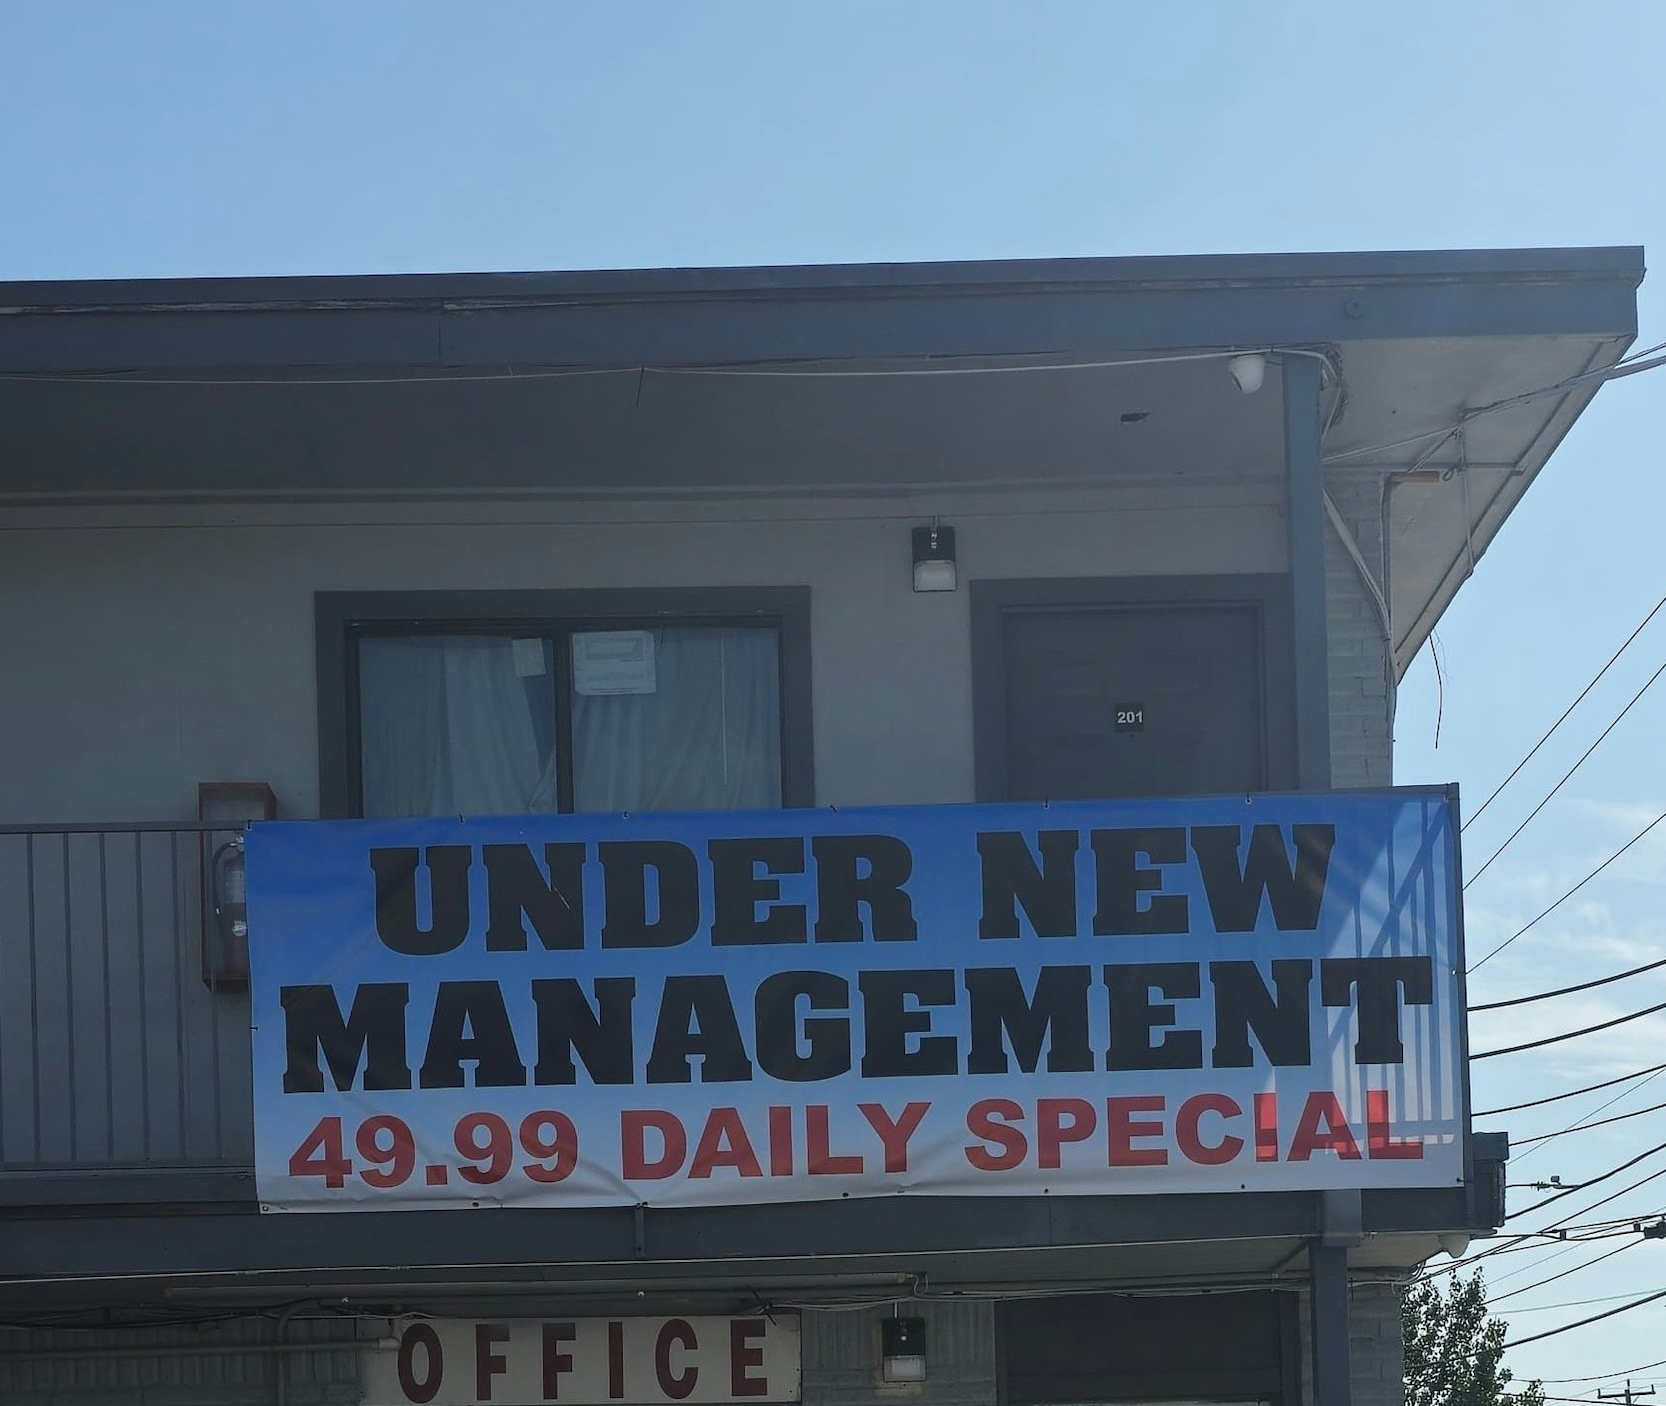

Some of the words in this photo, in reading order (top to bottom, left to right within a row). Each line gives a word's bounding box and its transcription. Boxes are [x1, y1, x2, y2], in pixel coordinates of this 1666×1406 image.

[1117, 711, 1144, 724] 201
[370, 834, 918, 955] UNDER
[976, 823, 1336, 944] NEW
[279, 956, 1432, 1094] MANAGEMENT
[288, 1109, 578, 1190] 49.99
[621, 1100, 932, 1180] DAILY
[964, 1089, 1426, 1173] SPECIAL
[397, 1318, 768, 1404] OFFICE
